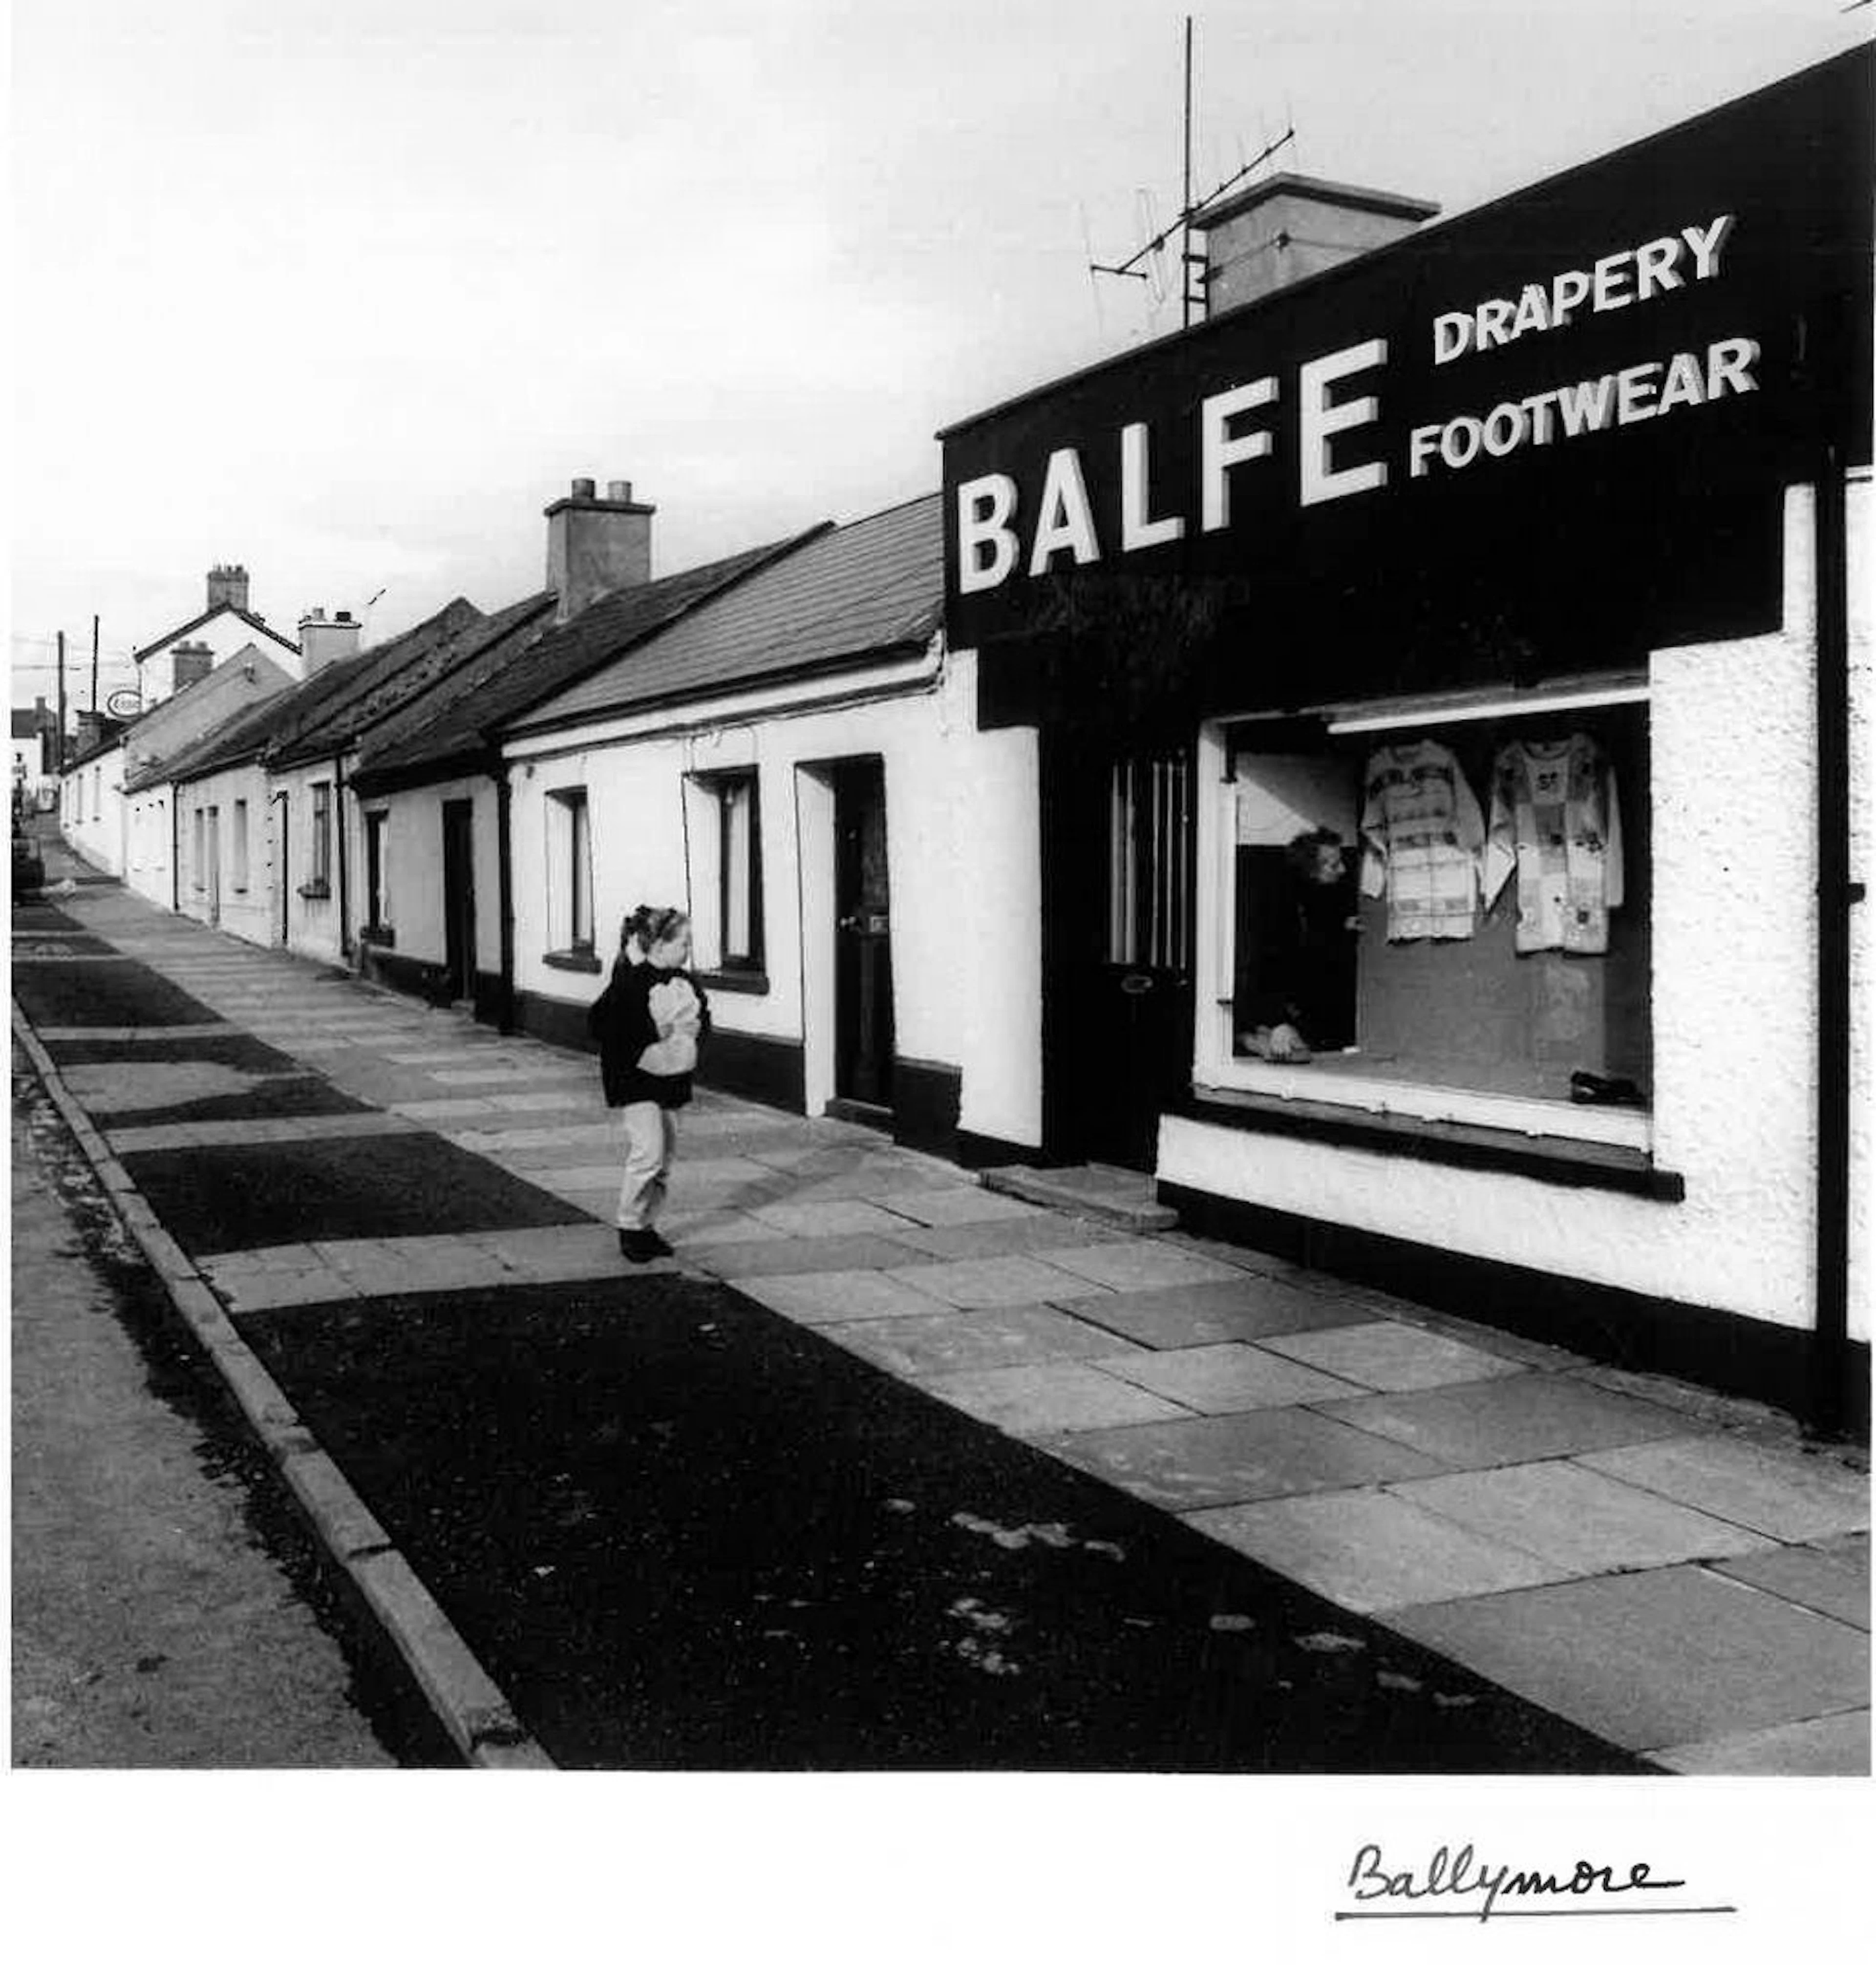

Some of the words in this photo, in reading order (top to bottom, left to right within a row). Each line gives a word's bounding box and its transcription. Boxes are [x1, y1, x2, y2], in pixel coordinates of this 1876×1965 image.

[1433, 215, 1734, 365] DRAPERY
[958, 338, 1388, 594] BALFE
[1410, 337, 1761, 478] FOOTWEAR
